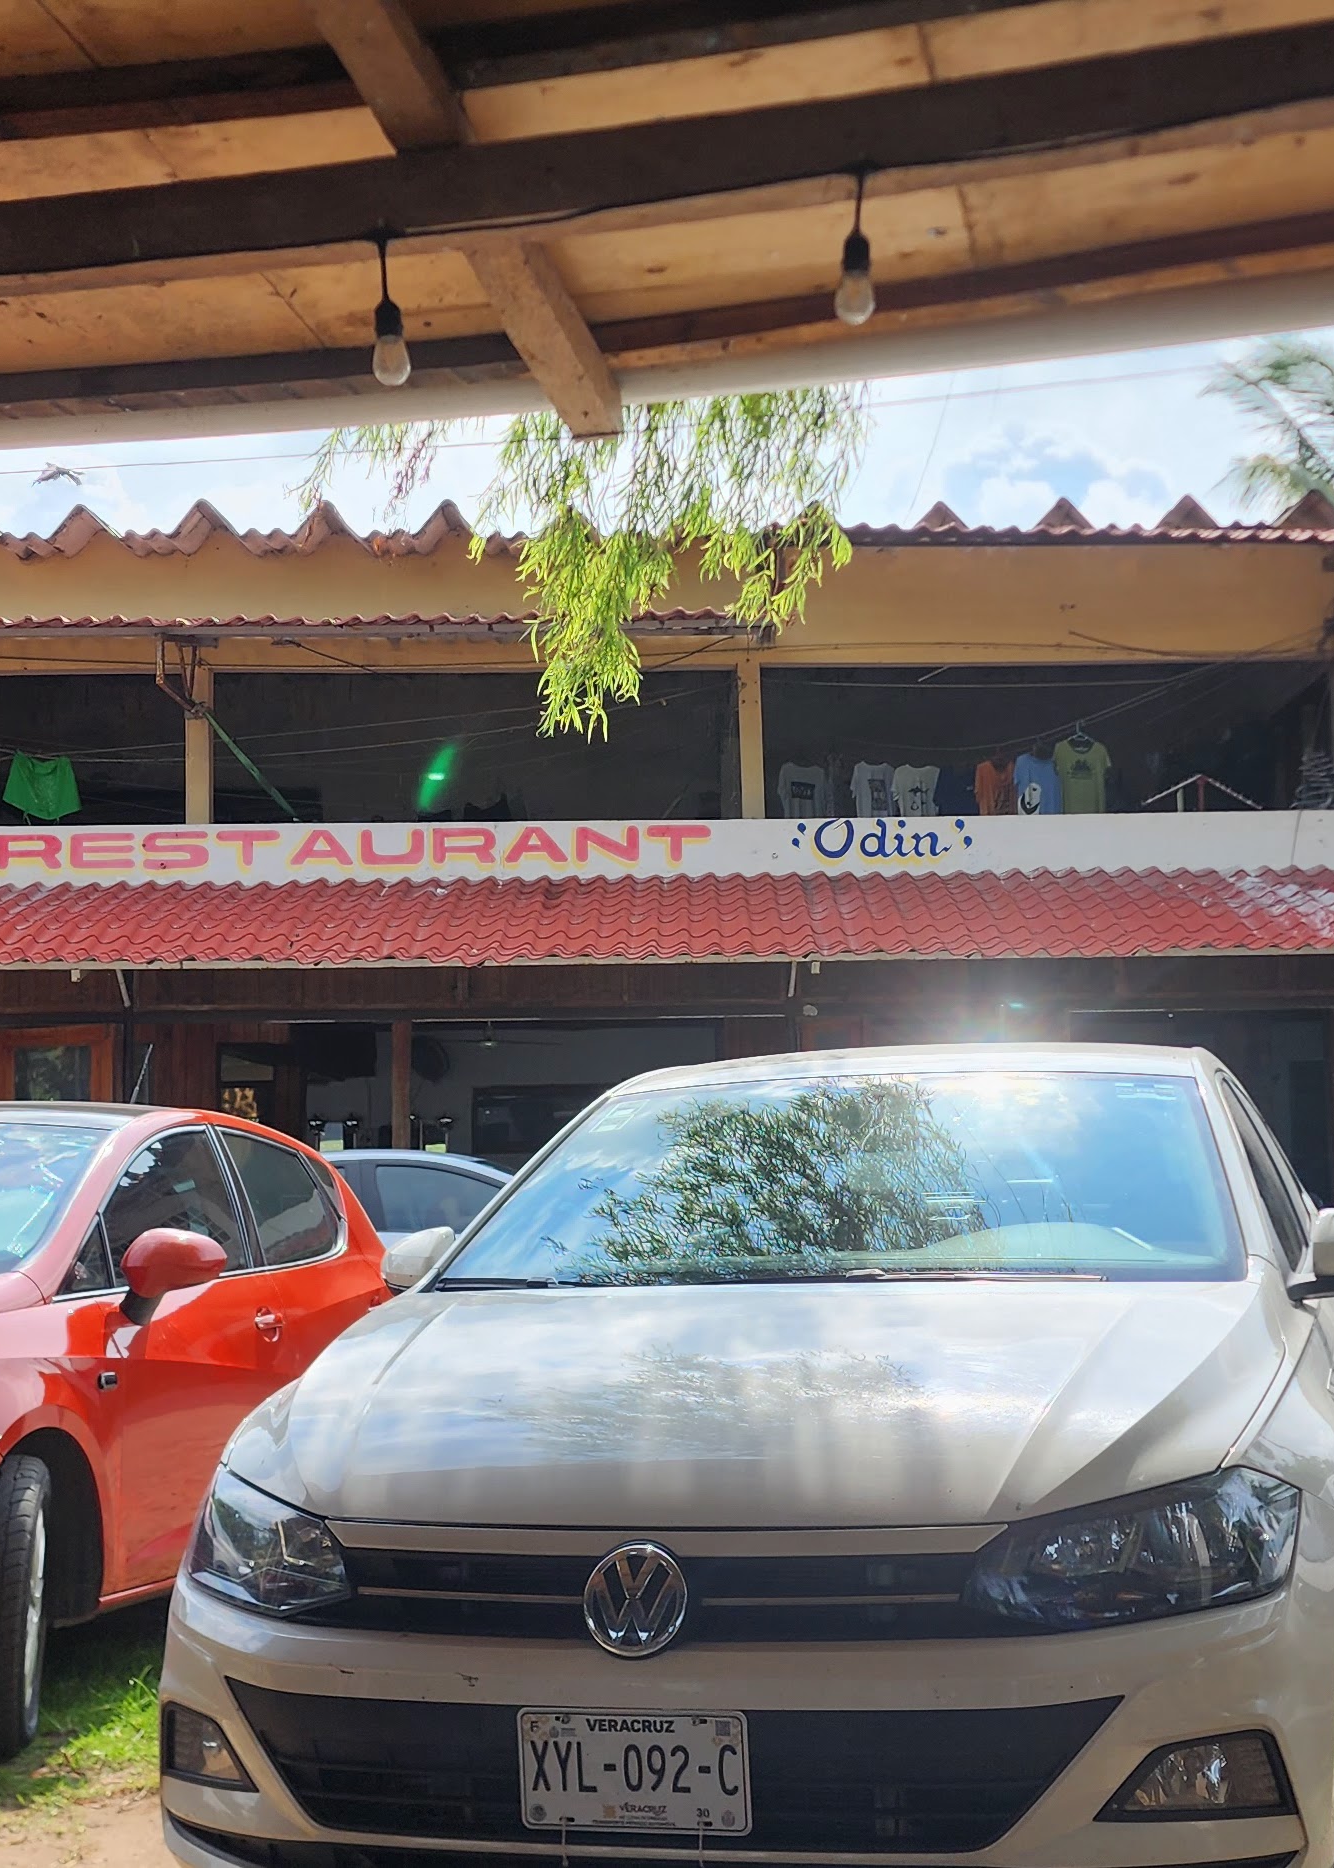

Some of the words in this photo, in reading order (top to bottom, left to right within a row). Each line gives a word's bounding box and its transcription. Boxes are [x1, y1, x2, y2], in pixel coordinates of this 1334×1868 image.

[586, 1719, 675, 1733] VERACRUZ
[530, 1740, 739, 1796] XYL-092-C
[697, 1808, 710, 1818] 30
